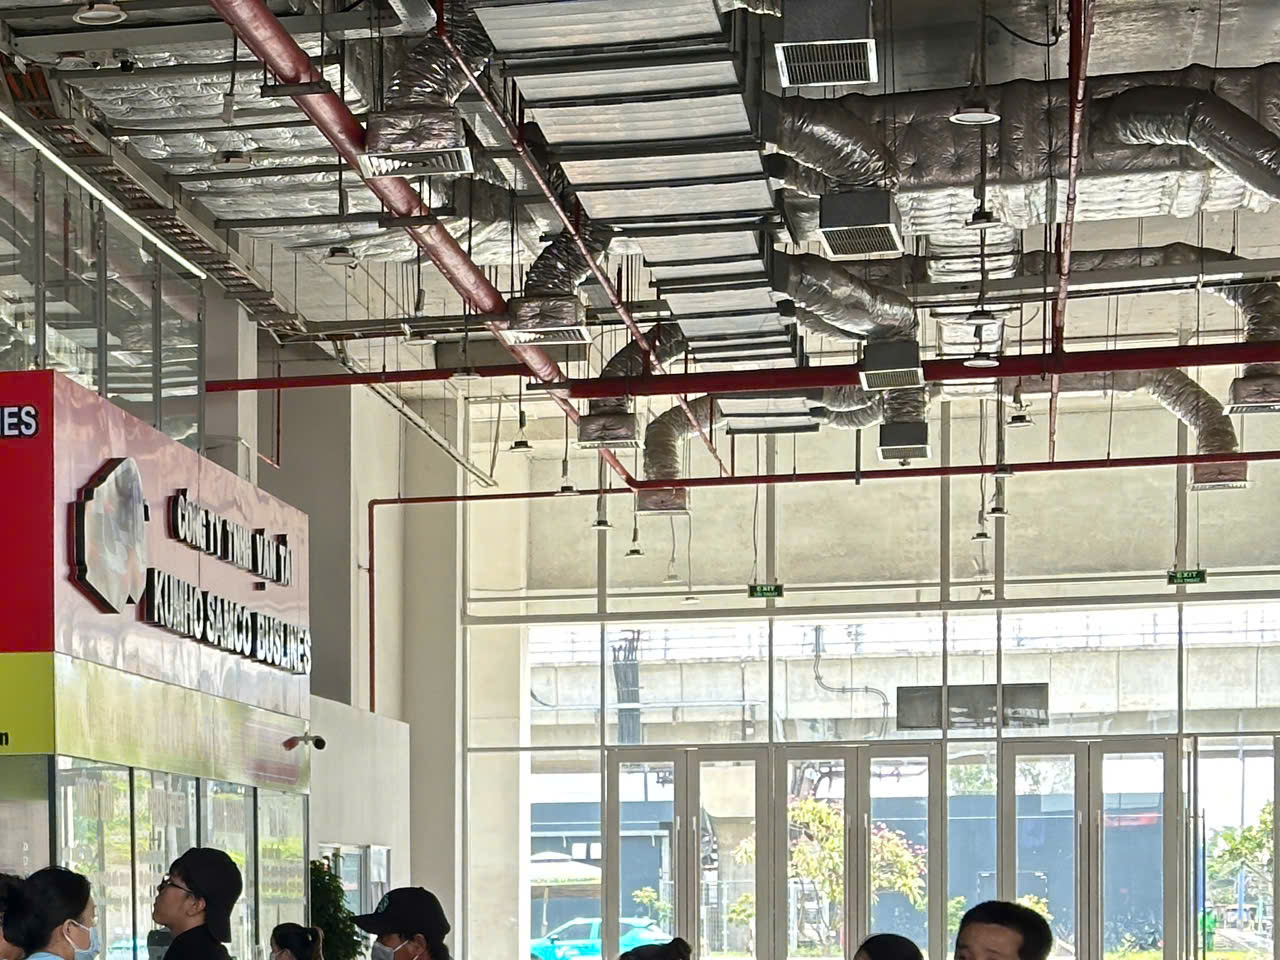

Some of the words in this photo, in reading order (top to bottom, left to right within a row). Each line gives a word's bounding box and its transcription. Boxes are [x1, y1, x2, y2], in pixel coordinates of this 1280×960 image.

[154, 568, 204, 639] KUMHO
[206, 593, 252, 656] SAMCO
[256, 613, 312, 675] BUSLINES
